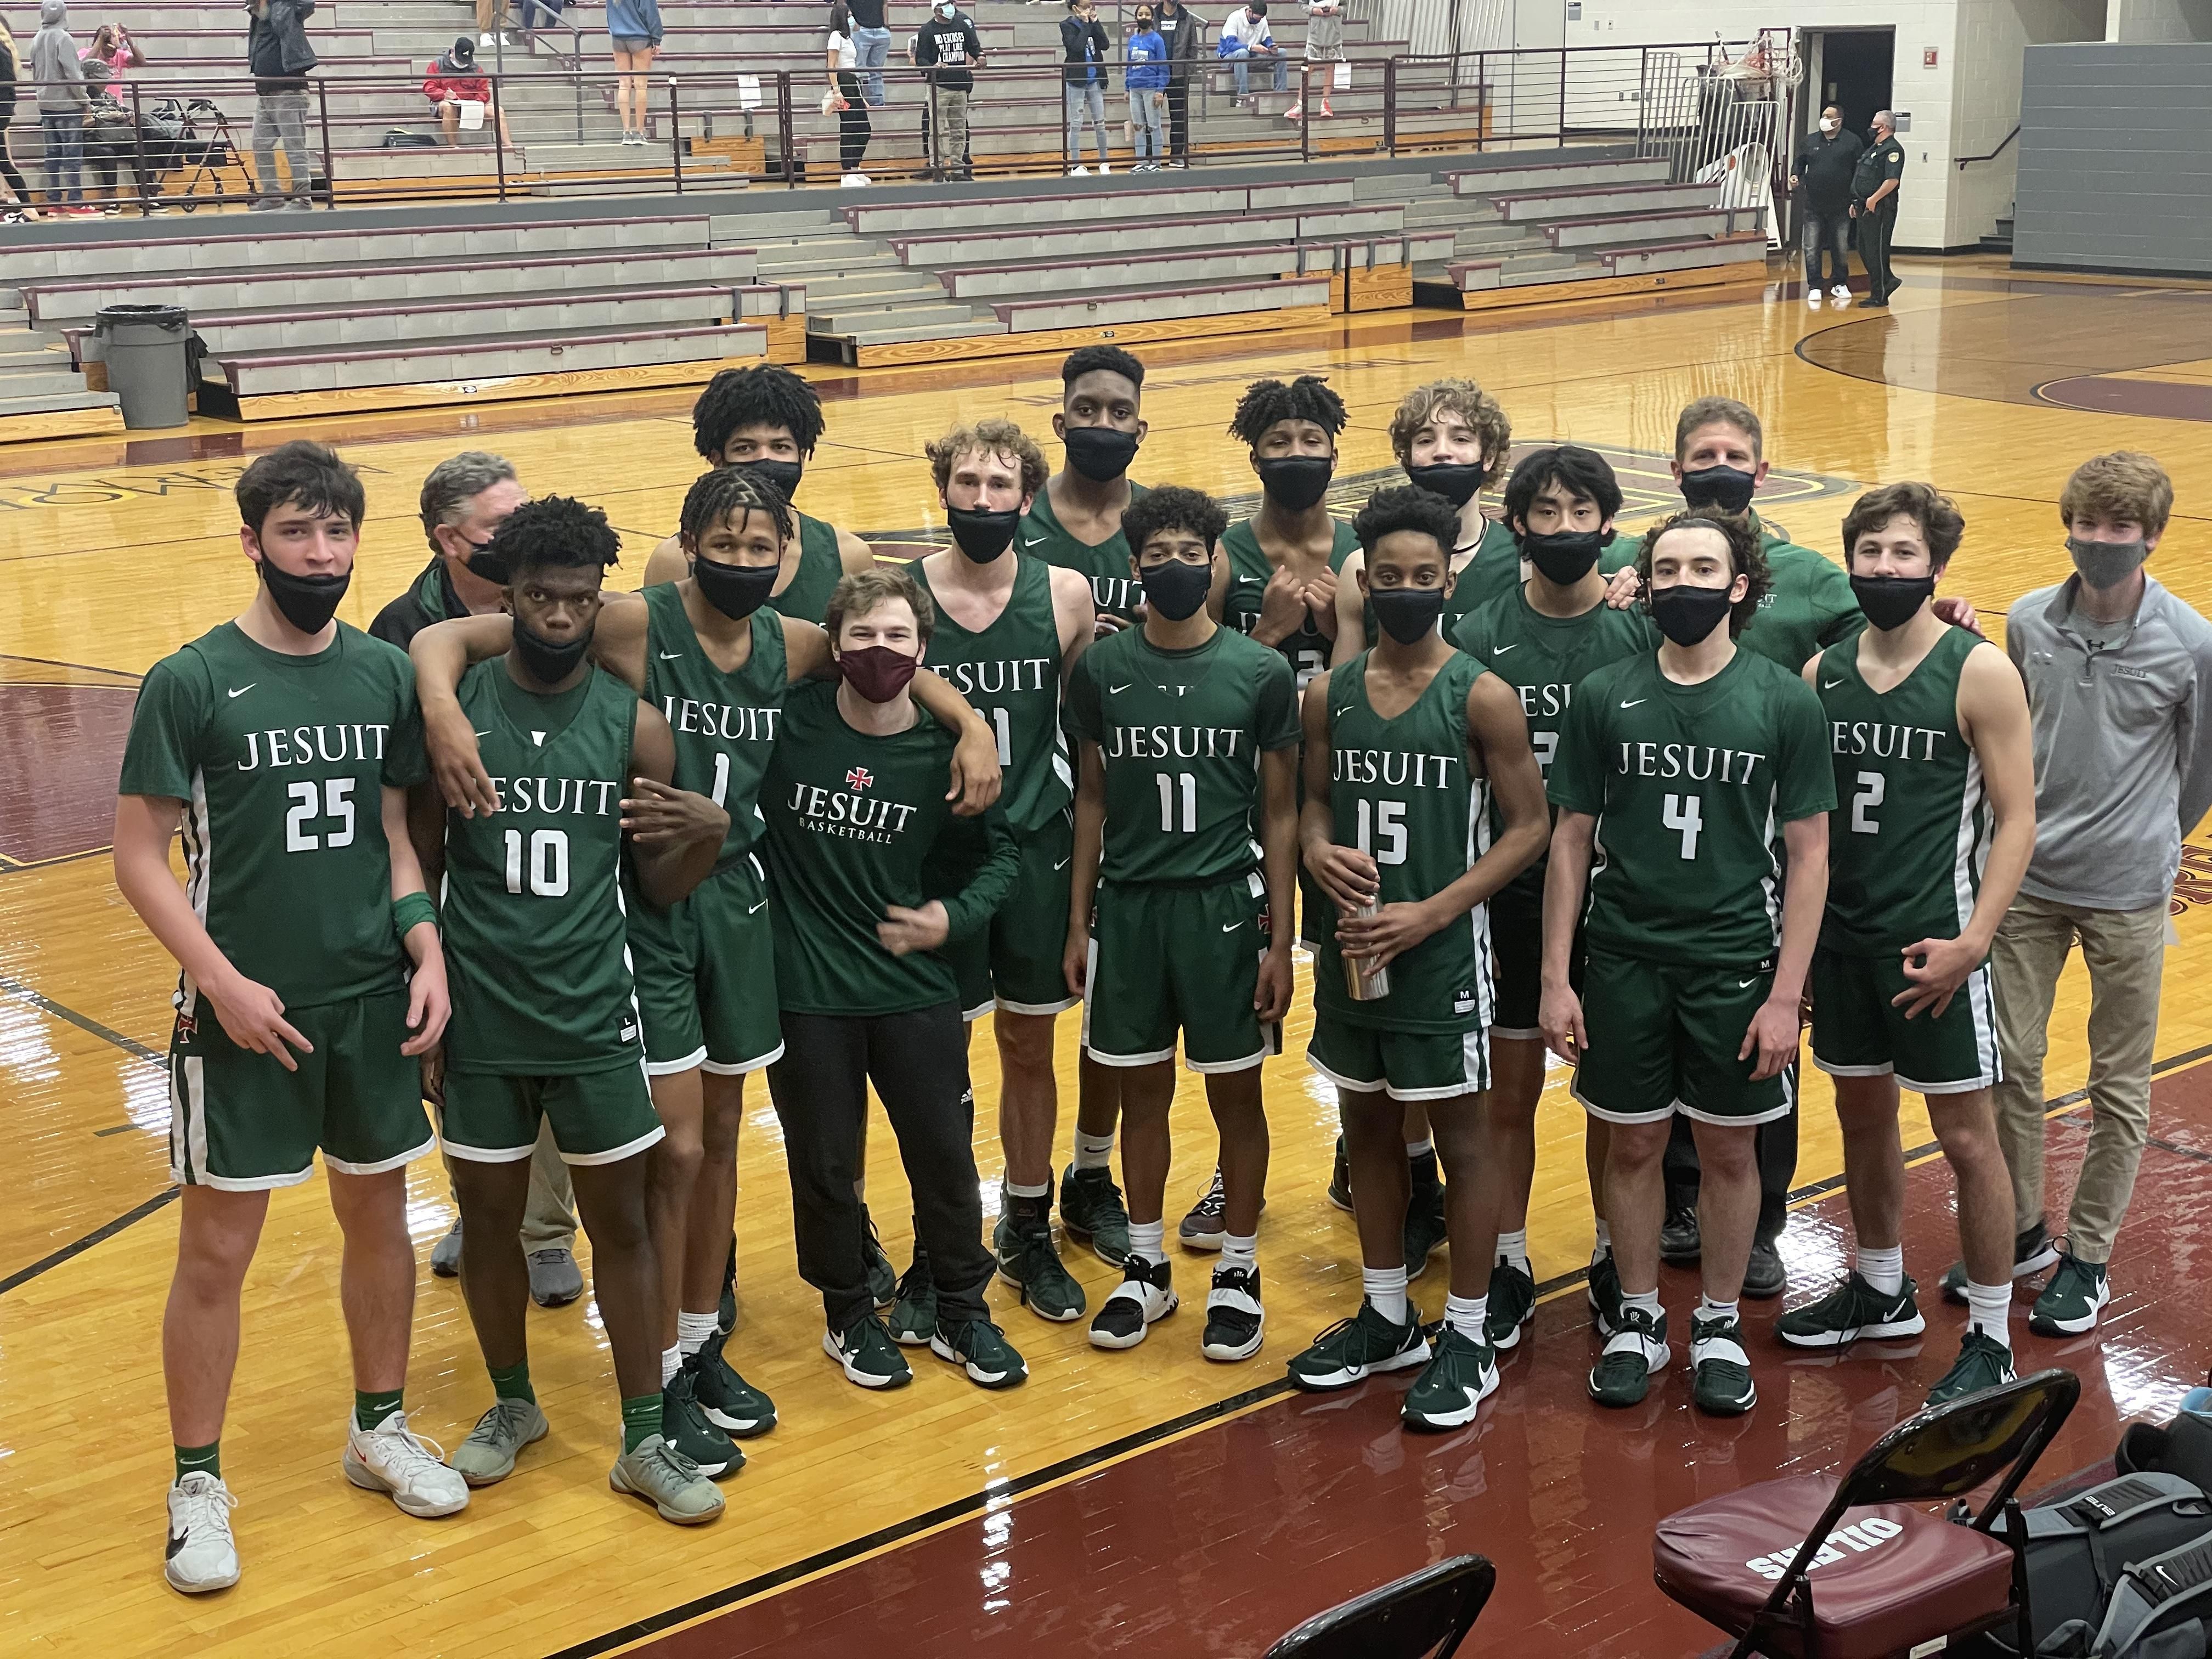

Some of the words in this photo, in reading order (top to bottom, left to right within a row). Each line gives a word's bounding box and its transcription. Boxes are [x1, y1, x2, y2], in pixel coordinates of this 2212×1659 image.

[664, 695, 782, 741] JESUIT
[1827, 721, 1946, 761] ESUIT
[238, 724, 389, 770] JESUIT
[1109, 726, 1244, 758] JESUIT
[1618, 742, 1765, 785] JESUIT
[712, 753, 730, 808] 1
[1333, 749, 1458, 789] JESUIT
[286, 777, 356, 853] 25
[471, 777, 617, 816] ESUIT
[787, 782, 917, 833] JESUIT
[1156, 773, 1196, 832] 11
[1852, 771, 1885, 834] 2
[799, 817, 891, 844] BASKETBALL
[1357, 799, 1407, 865] 15
[1662, 793, 1702, 860] 4
[505, 829, 568, 896] 10
[1761, 960, 1770, 969] M
[1460, 990, 1469, 999] M
[624, 1017, 631, 1025] L
